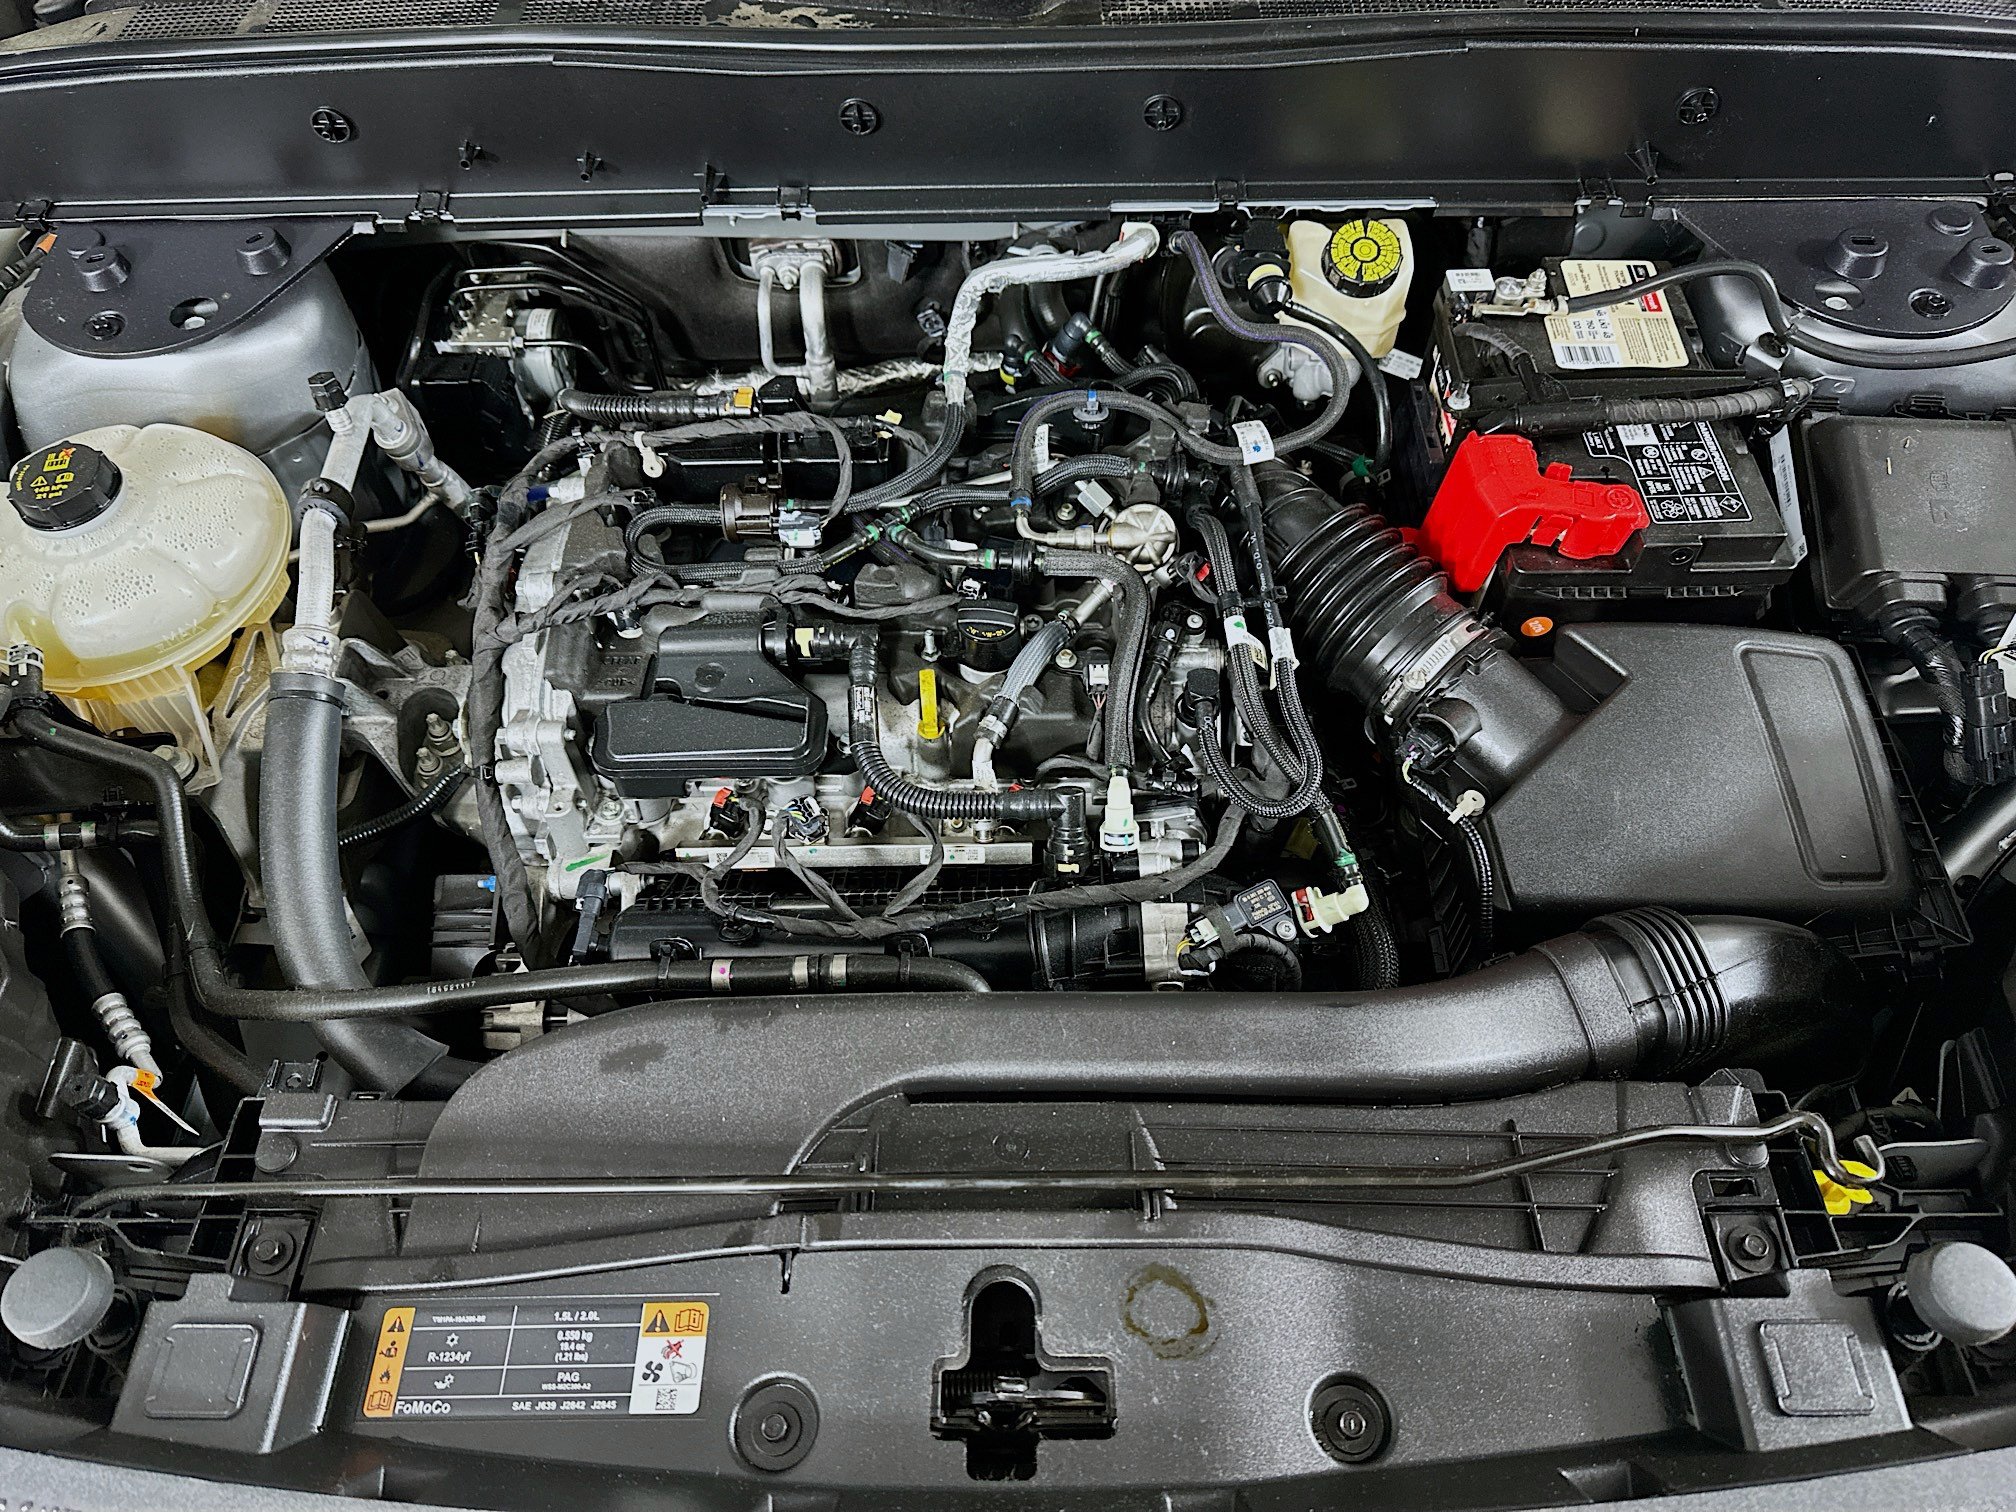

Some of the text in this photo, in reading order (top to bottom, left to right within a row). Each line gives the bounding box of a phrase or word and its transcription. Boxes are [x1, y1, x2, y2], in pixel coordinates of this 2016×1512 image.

[554, 1311, 574, 1321] 1.5L
[580, 1311, 600, 1321] 2.0L
[557, 1330, 594, 1343] 0.550 kg
[427, 1351, 472, 1364] R-1234yf
[557, 1372, 580, 1382] PAG
[394, 1400, 451, 1414] FoMoCo
[512, 1401, 532, 1411] SAE
[535, 1401, 557, 1410] J639
